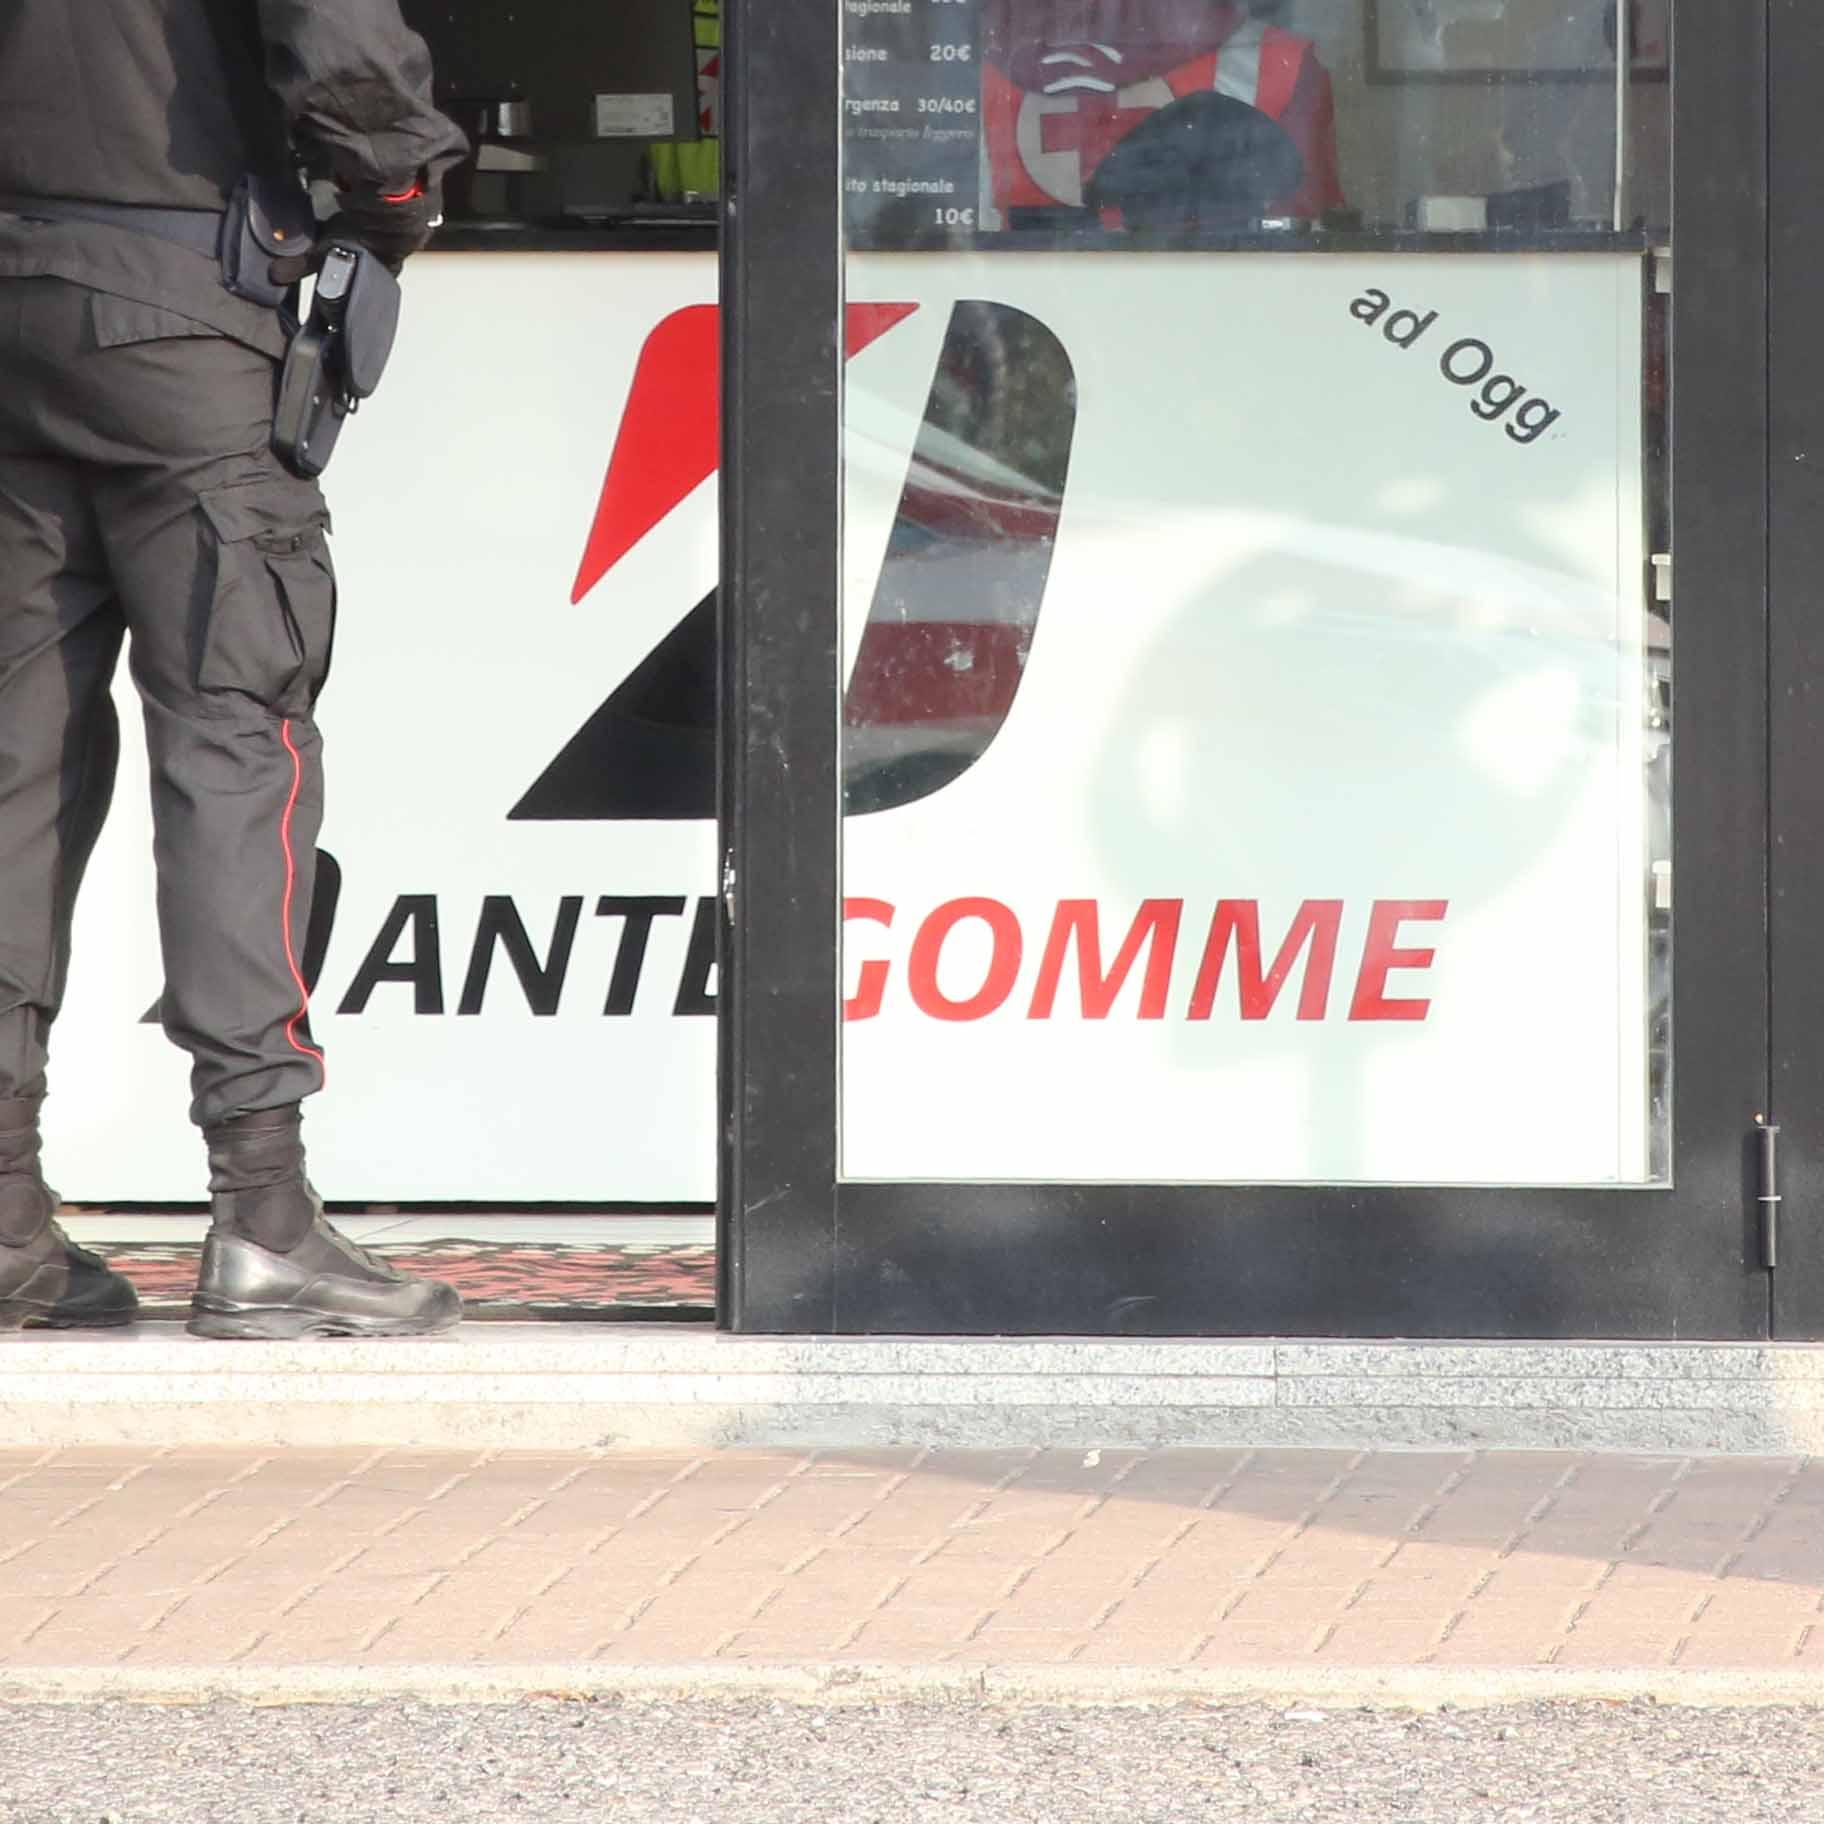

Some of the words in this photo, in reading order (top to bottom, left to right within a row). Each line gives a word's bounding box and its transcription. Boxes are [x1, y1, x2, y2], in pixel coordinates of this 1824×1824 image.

[929, 44, 972, 62] 20€
[934, 206, 975, 225] 10€
[1348, 287, 1439, 349] ad
[1440, 337, 1562, 445] Ogg
[843, 895, 1449, 1023] GOMME
